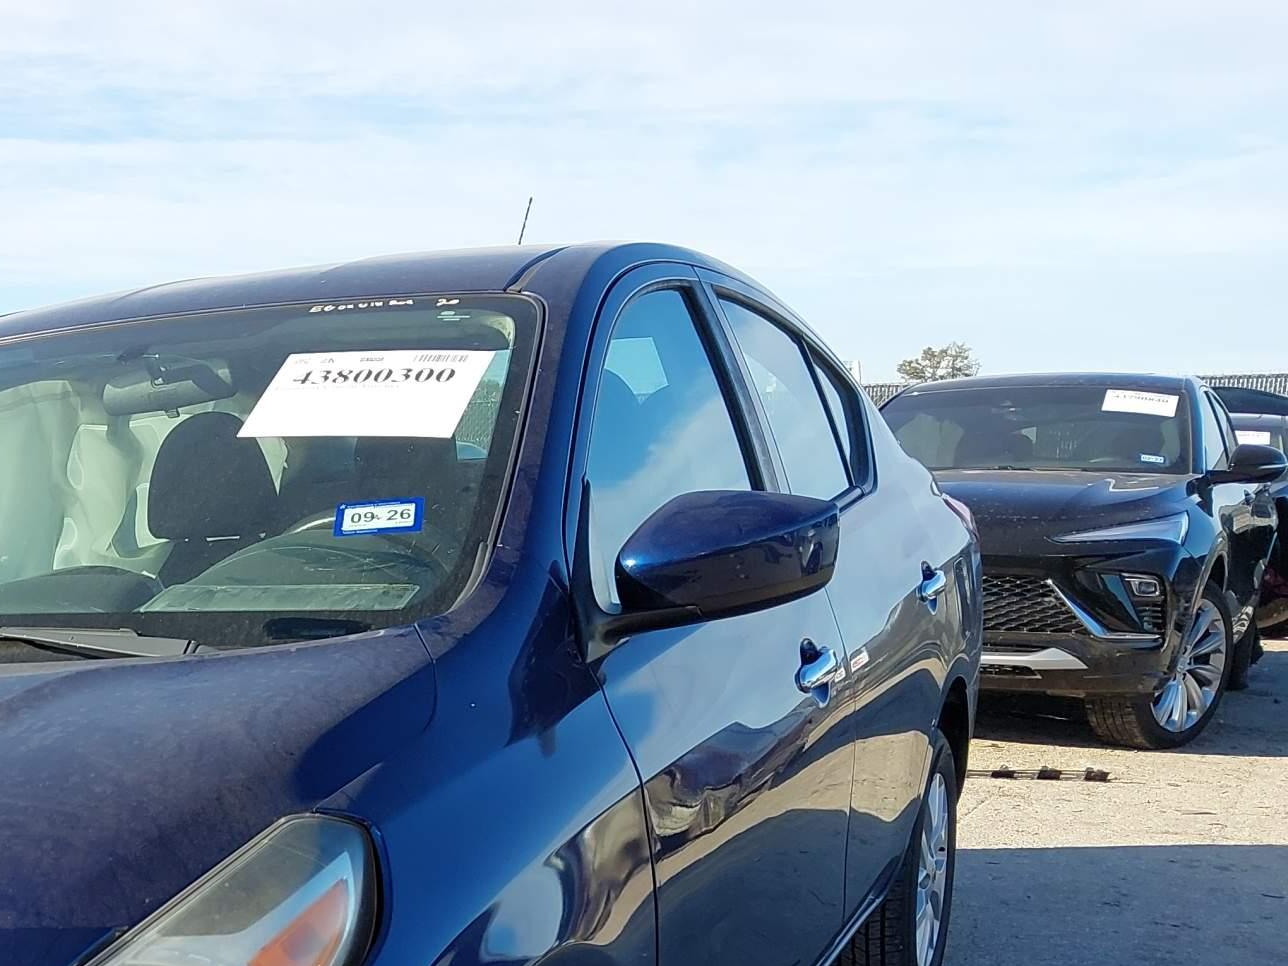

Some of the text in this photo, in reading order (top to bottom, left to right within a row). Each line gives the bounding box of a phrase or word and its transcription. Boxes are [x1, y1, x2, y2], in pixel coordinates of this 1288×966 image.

[293, 368, 456, 385] 43800300
[350, 508, 412, 524] 09 26
